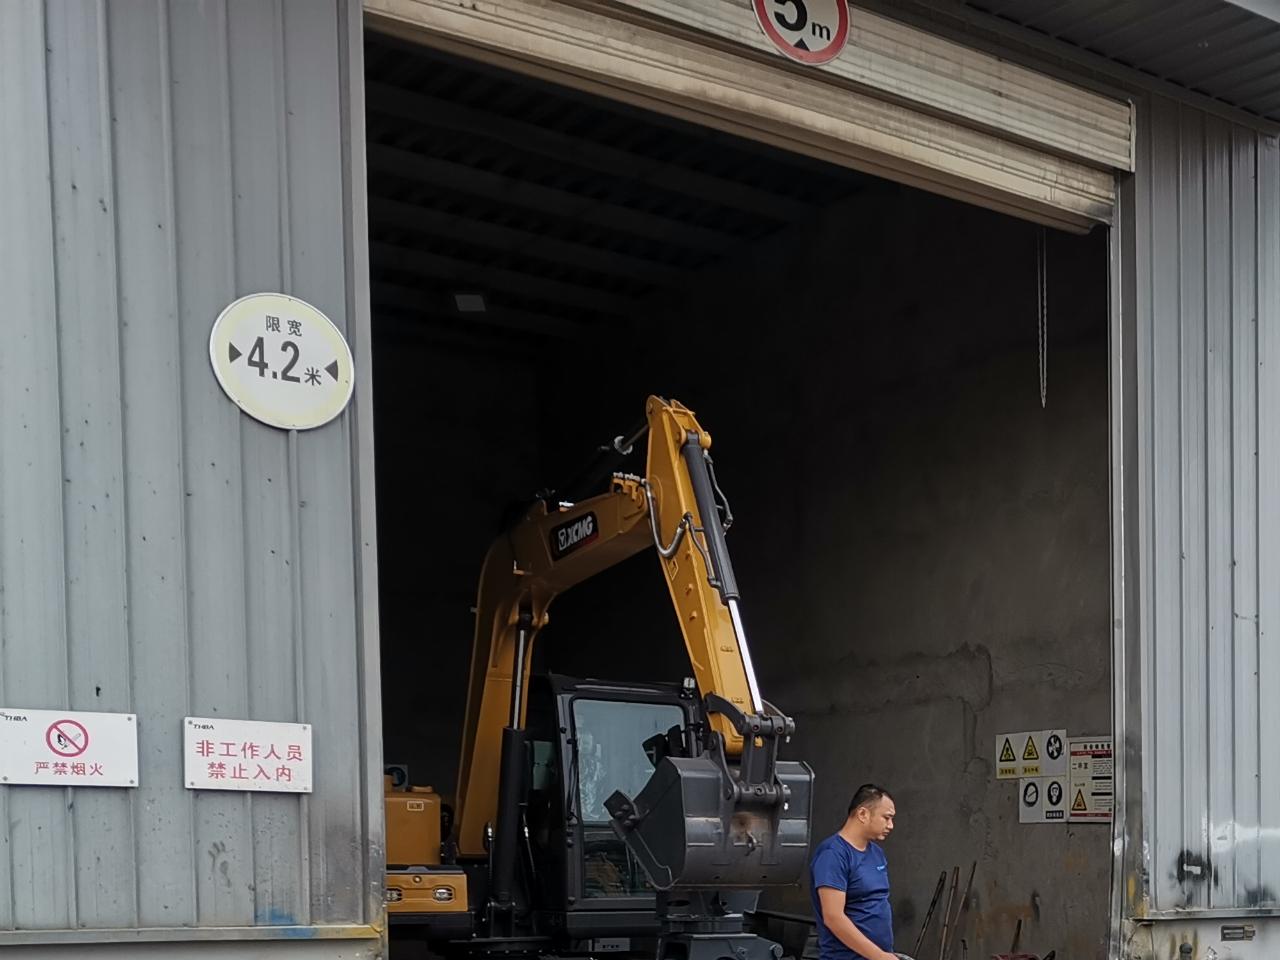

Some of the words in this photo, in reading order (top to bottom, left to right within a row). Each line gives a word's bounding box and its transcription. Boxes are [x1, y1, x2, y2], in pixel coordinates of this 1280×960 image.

[265, 315, 302, 337] 限宽
[566, 515, 593, 547] XCMG
[195, 739, 303, 761] 非工作人员
[34, 761, 104, 776] 严禁烟火
[207, 761, 292, 782] 禁止入内
